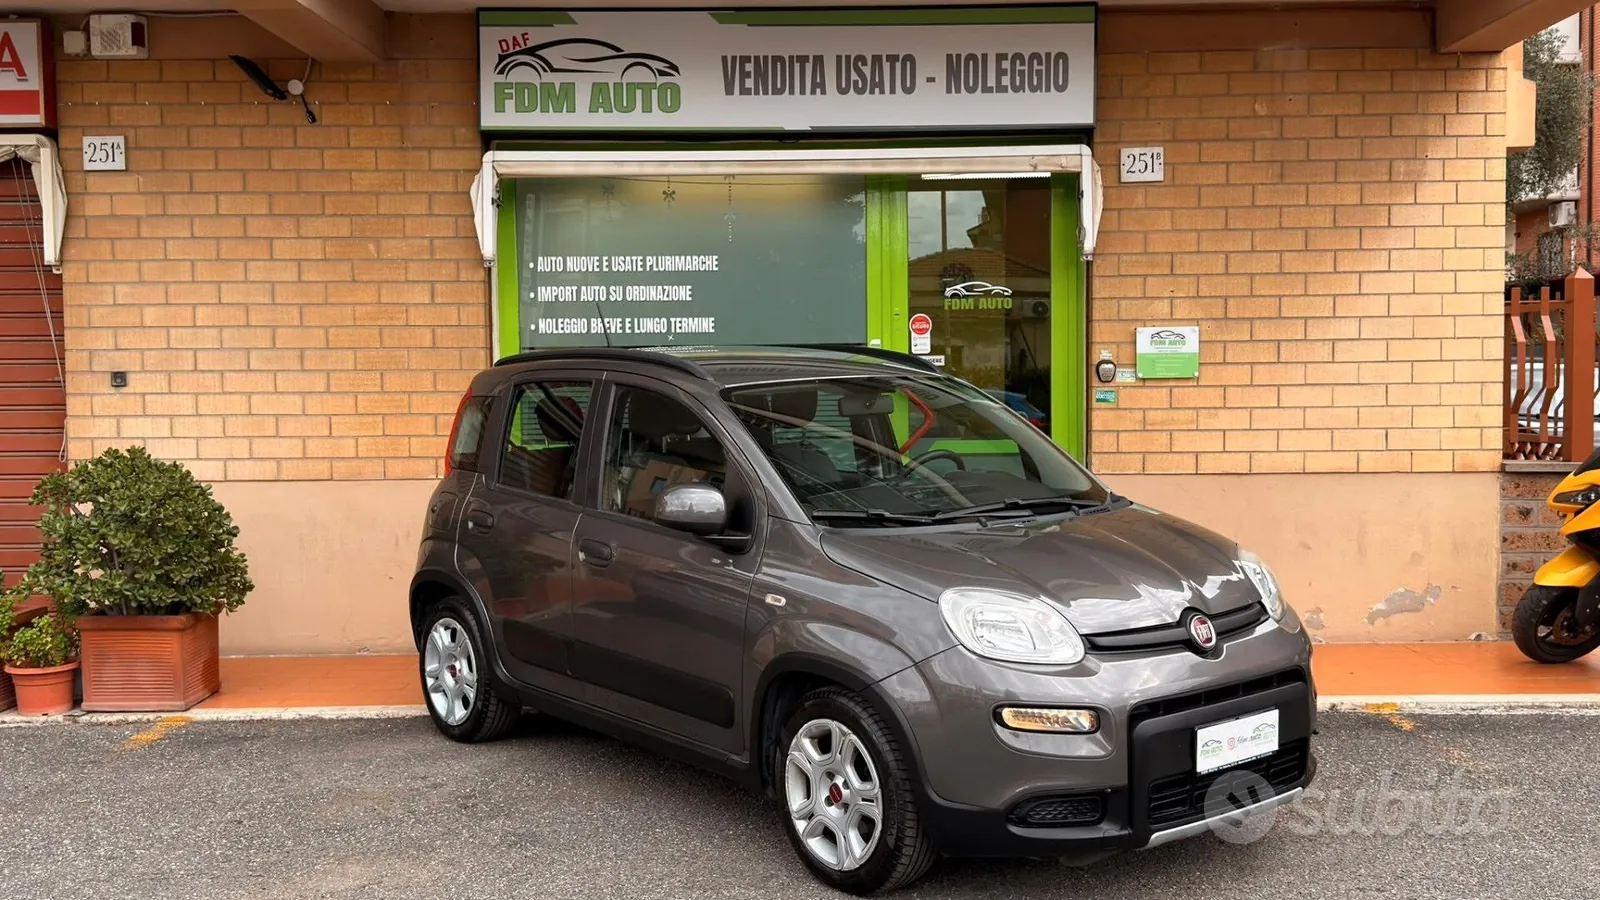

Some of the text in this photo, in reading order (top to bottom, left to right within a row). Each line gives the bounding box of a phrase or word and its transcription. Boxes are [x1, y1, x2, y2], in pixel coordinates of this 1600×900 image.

[498, 32, 530, 53] DAF
[721, 55, 827, 96] VENDITA
[835, 54, 917, 95] USATO
[945, 52, 1069, 94] NOLEGGIO
[494, 82, 681, 113] FDM AUTO
[537, 255, 719, 272] AUTO NUOVE E USATE PLURIMARCHE
[537, 285, 692, 302] IMPORT AUTO SU ORDINAZIONE
[944, 297, 1013, 310] FDM AUTO
[538, 317, 715, 334] NOLEGGIO BREVE E LUNGO TERMINE
